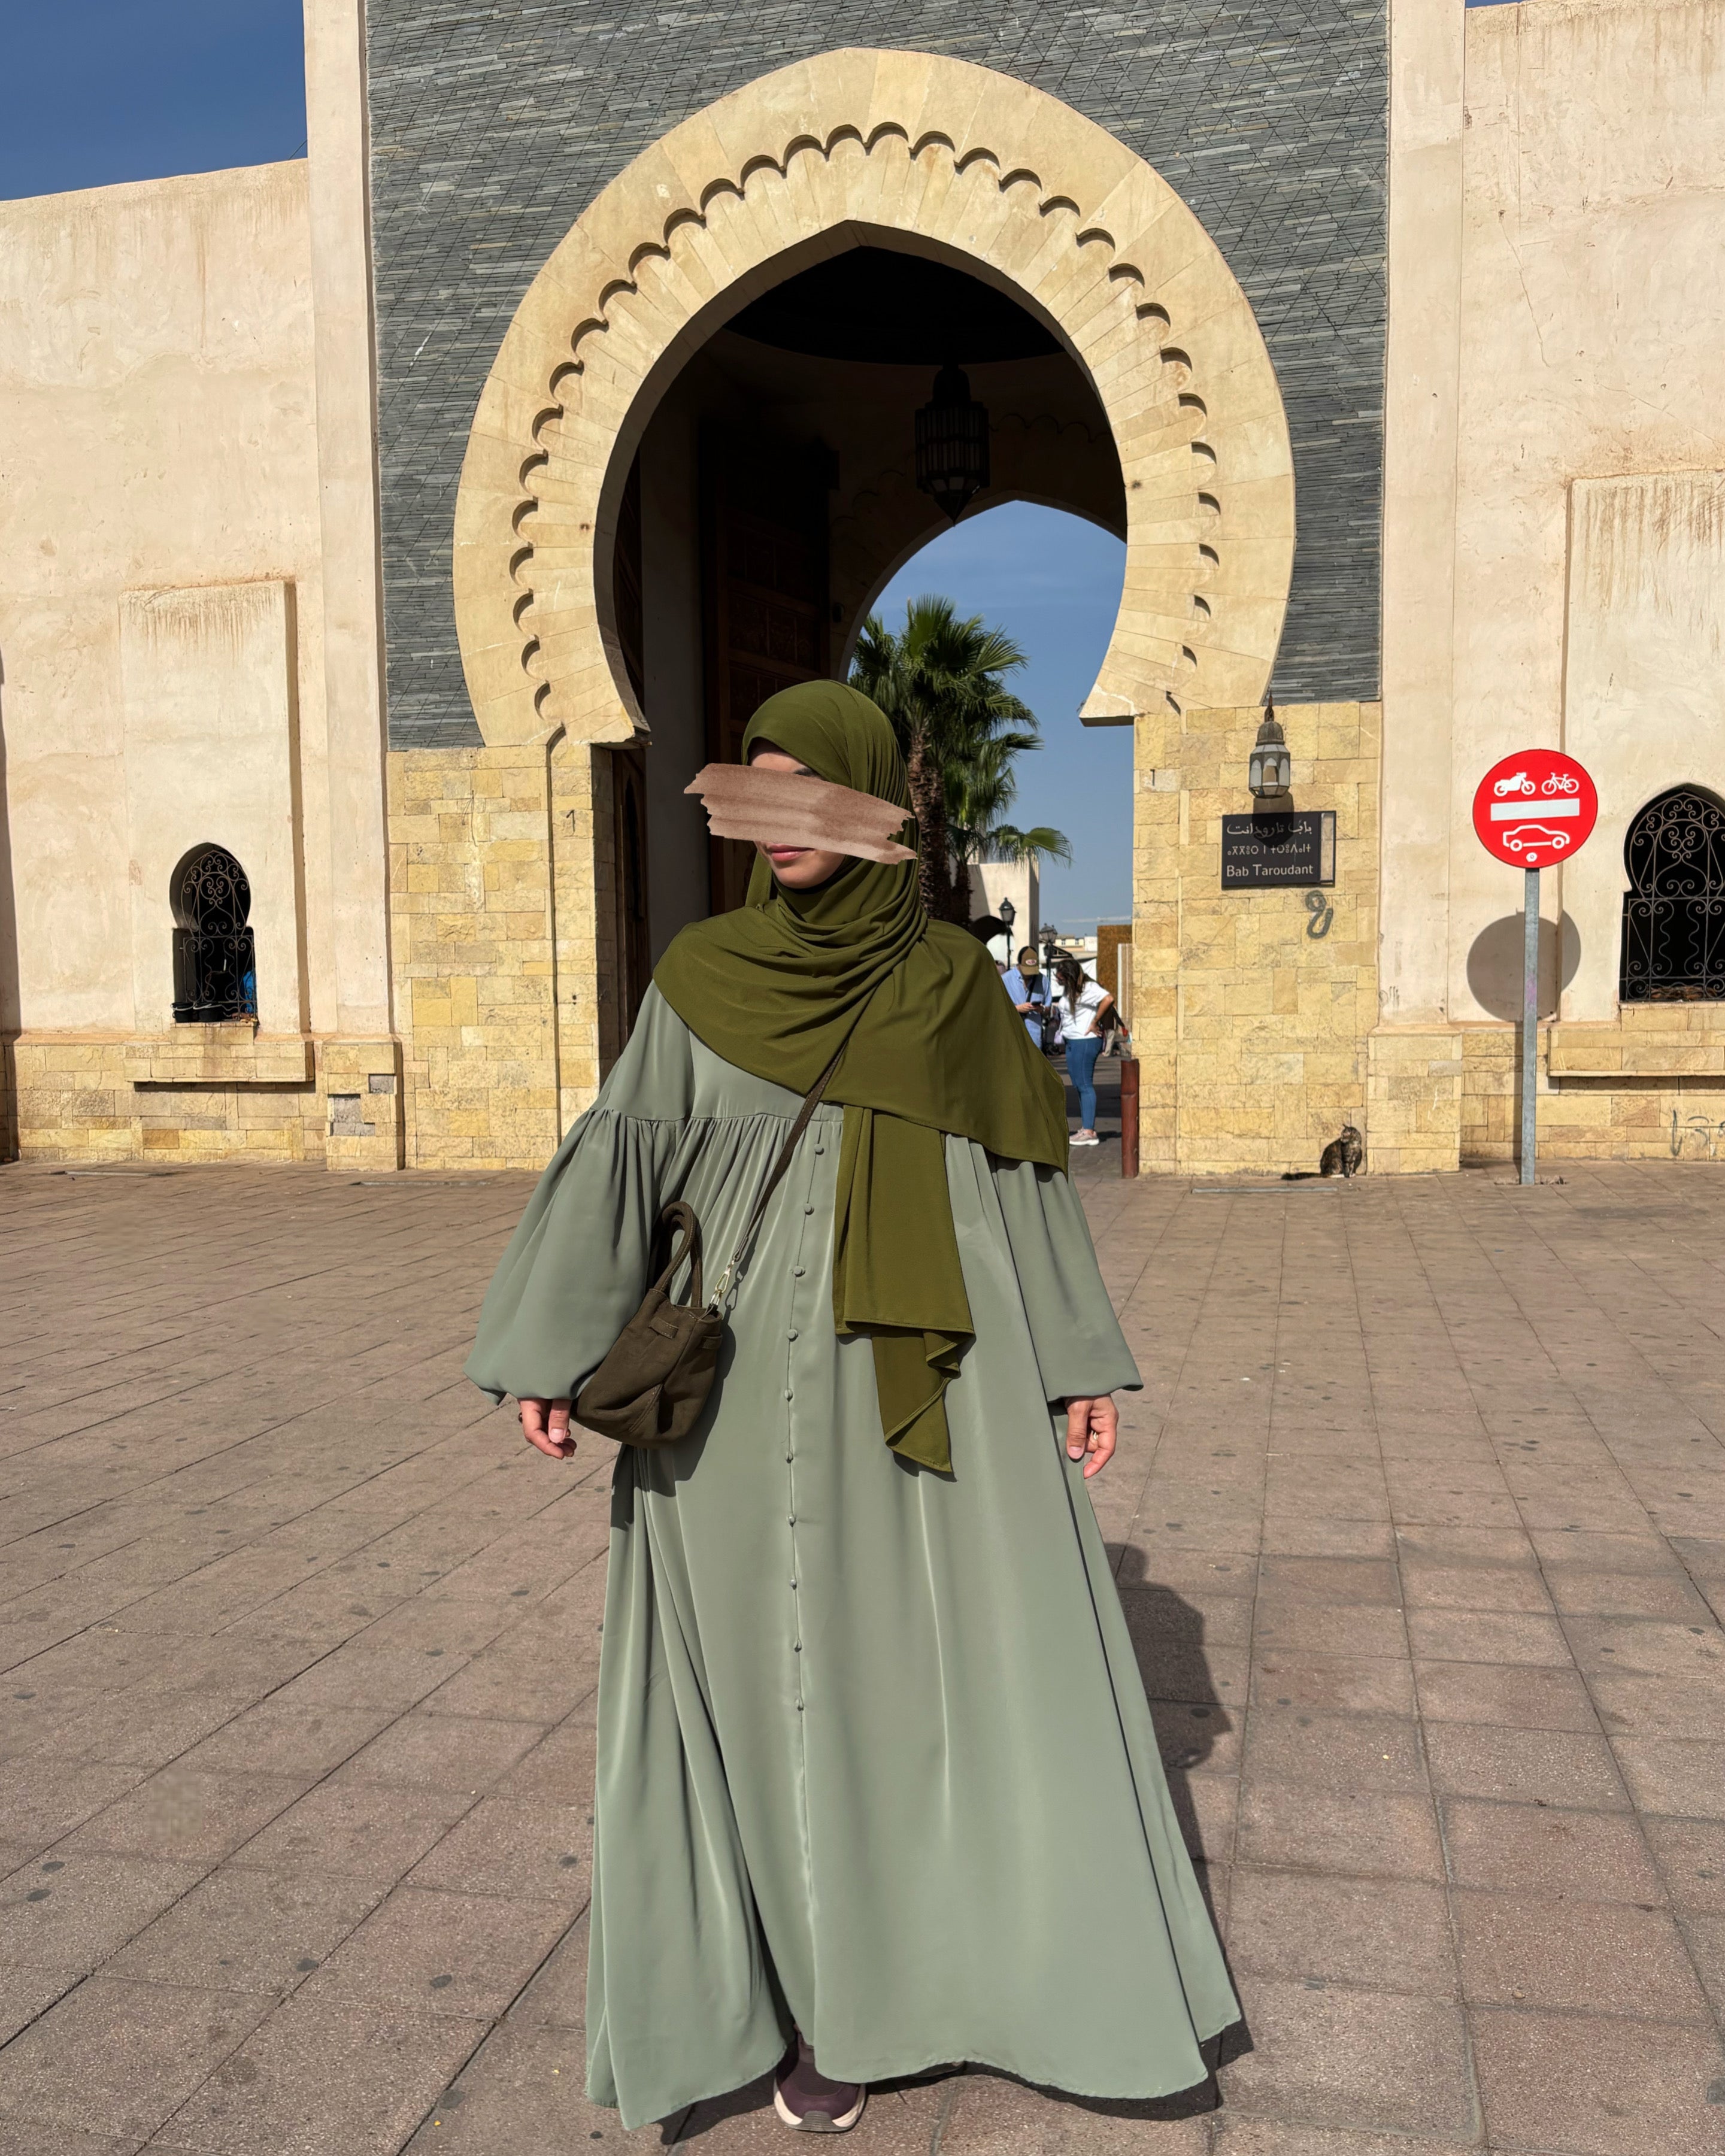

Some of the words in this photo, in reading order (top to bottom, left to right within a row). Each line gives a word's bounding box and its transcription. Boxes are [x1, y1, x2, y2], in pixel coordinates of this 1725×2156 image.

[1226, 822, 1285, 839] تارودانت
[1287, 821, 1312, 835] باب
[1226, 865, 1249, 877] Bab
[1252, 864, 1314, 877] Taroudant
